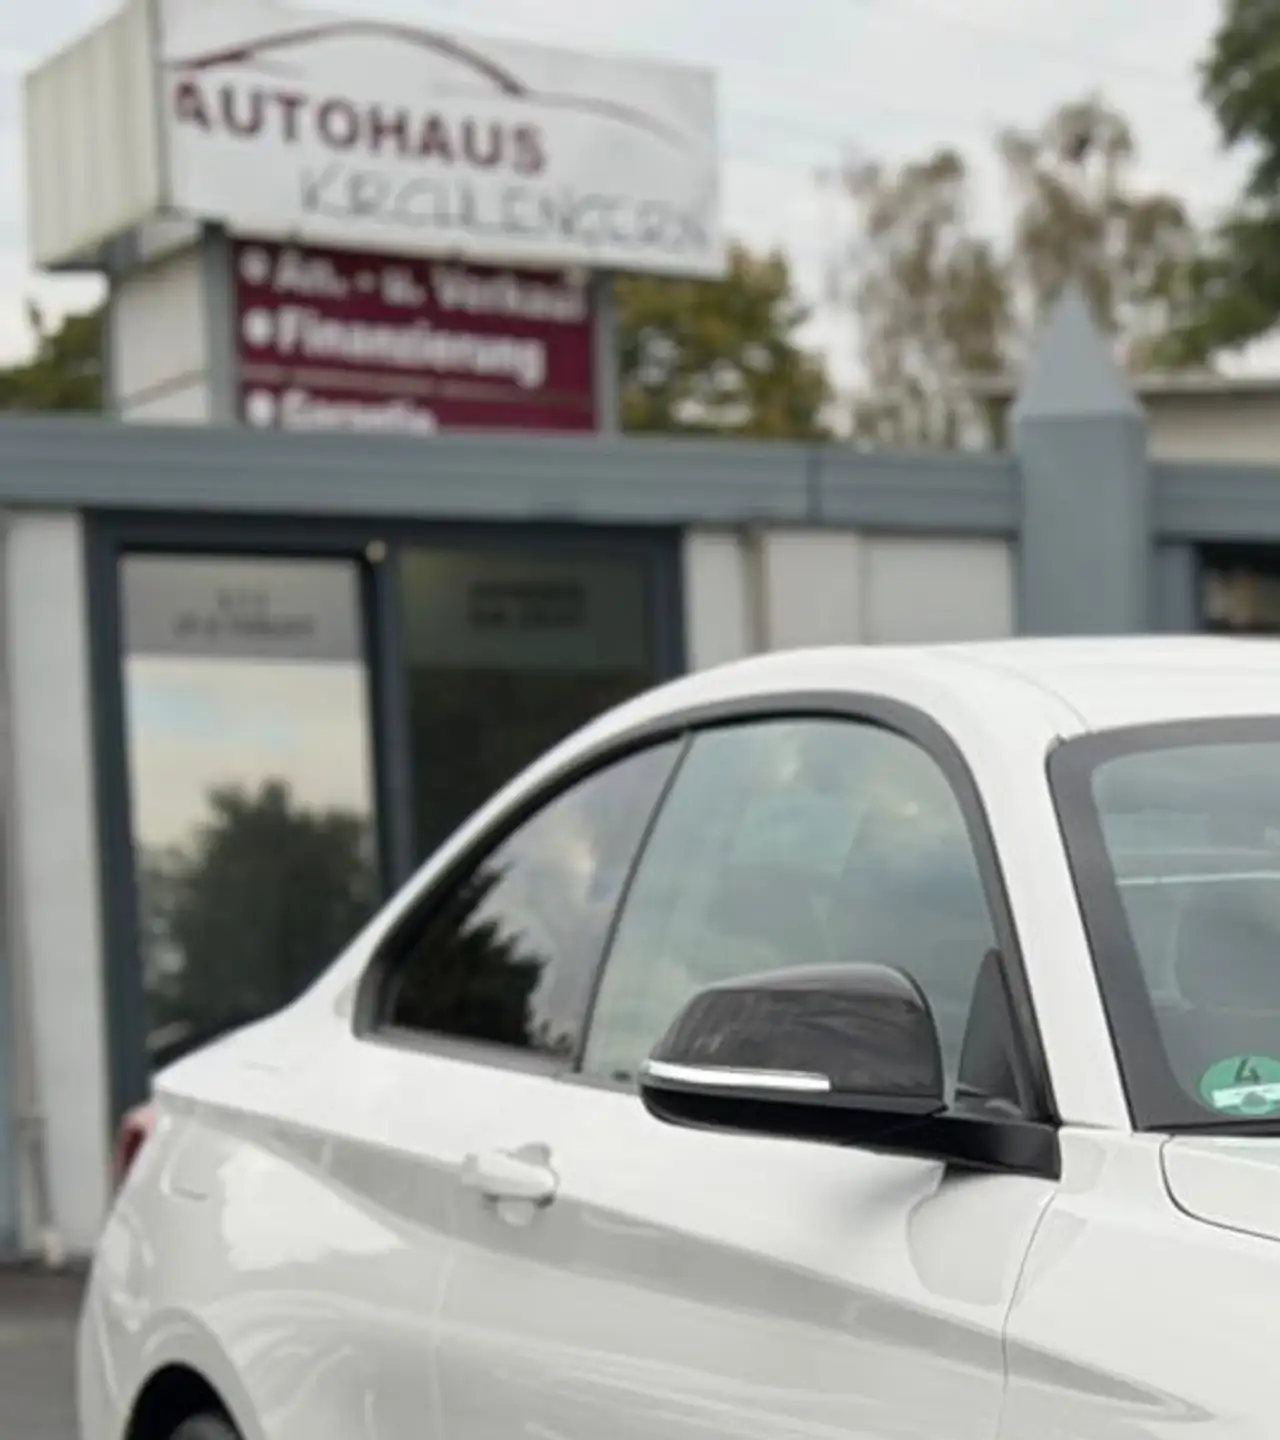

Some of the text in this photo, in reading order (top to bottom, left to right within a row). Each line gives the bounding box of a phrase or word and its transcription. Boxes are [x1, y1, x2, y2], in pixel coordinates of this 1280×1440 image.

[172, 77, 548, 175] AUTOHAUS
[275, 306, 547, 389] Finanzierung
[1234, 1057, 1262, 1086] 4
